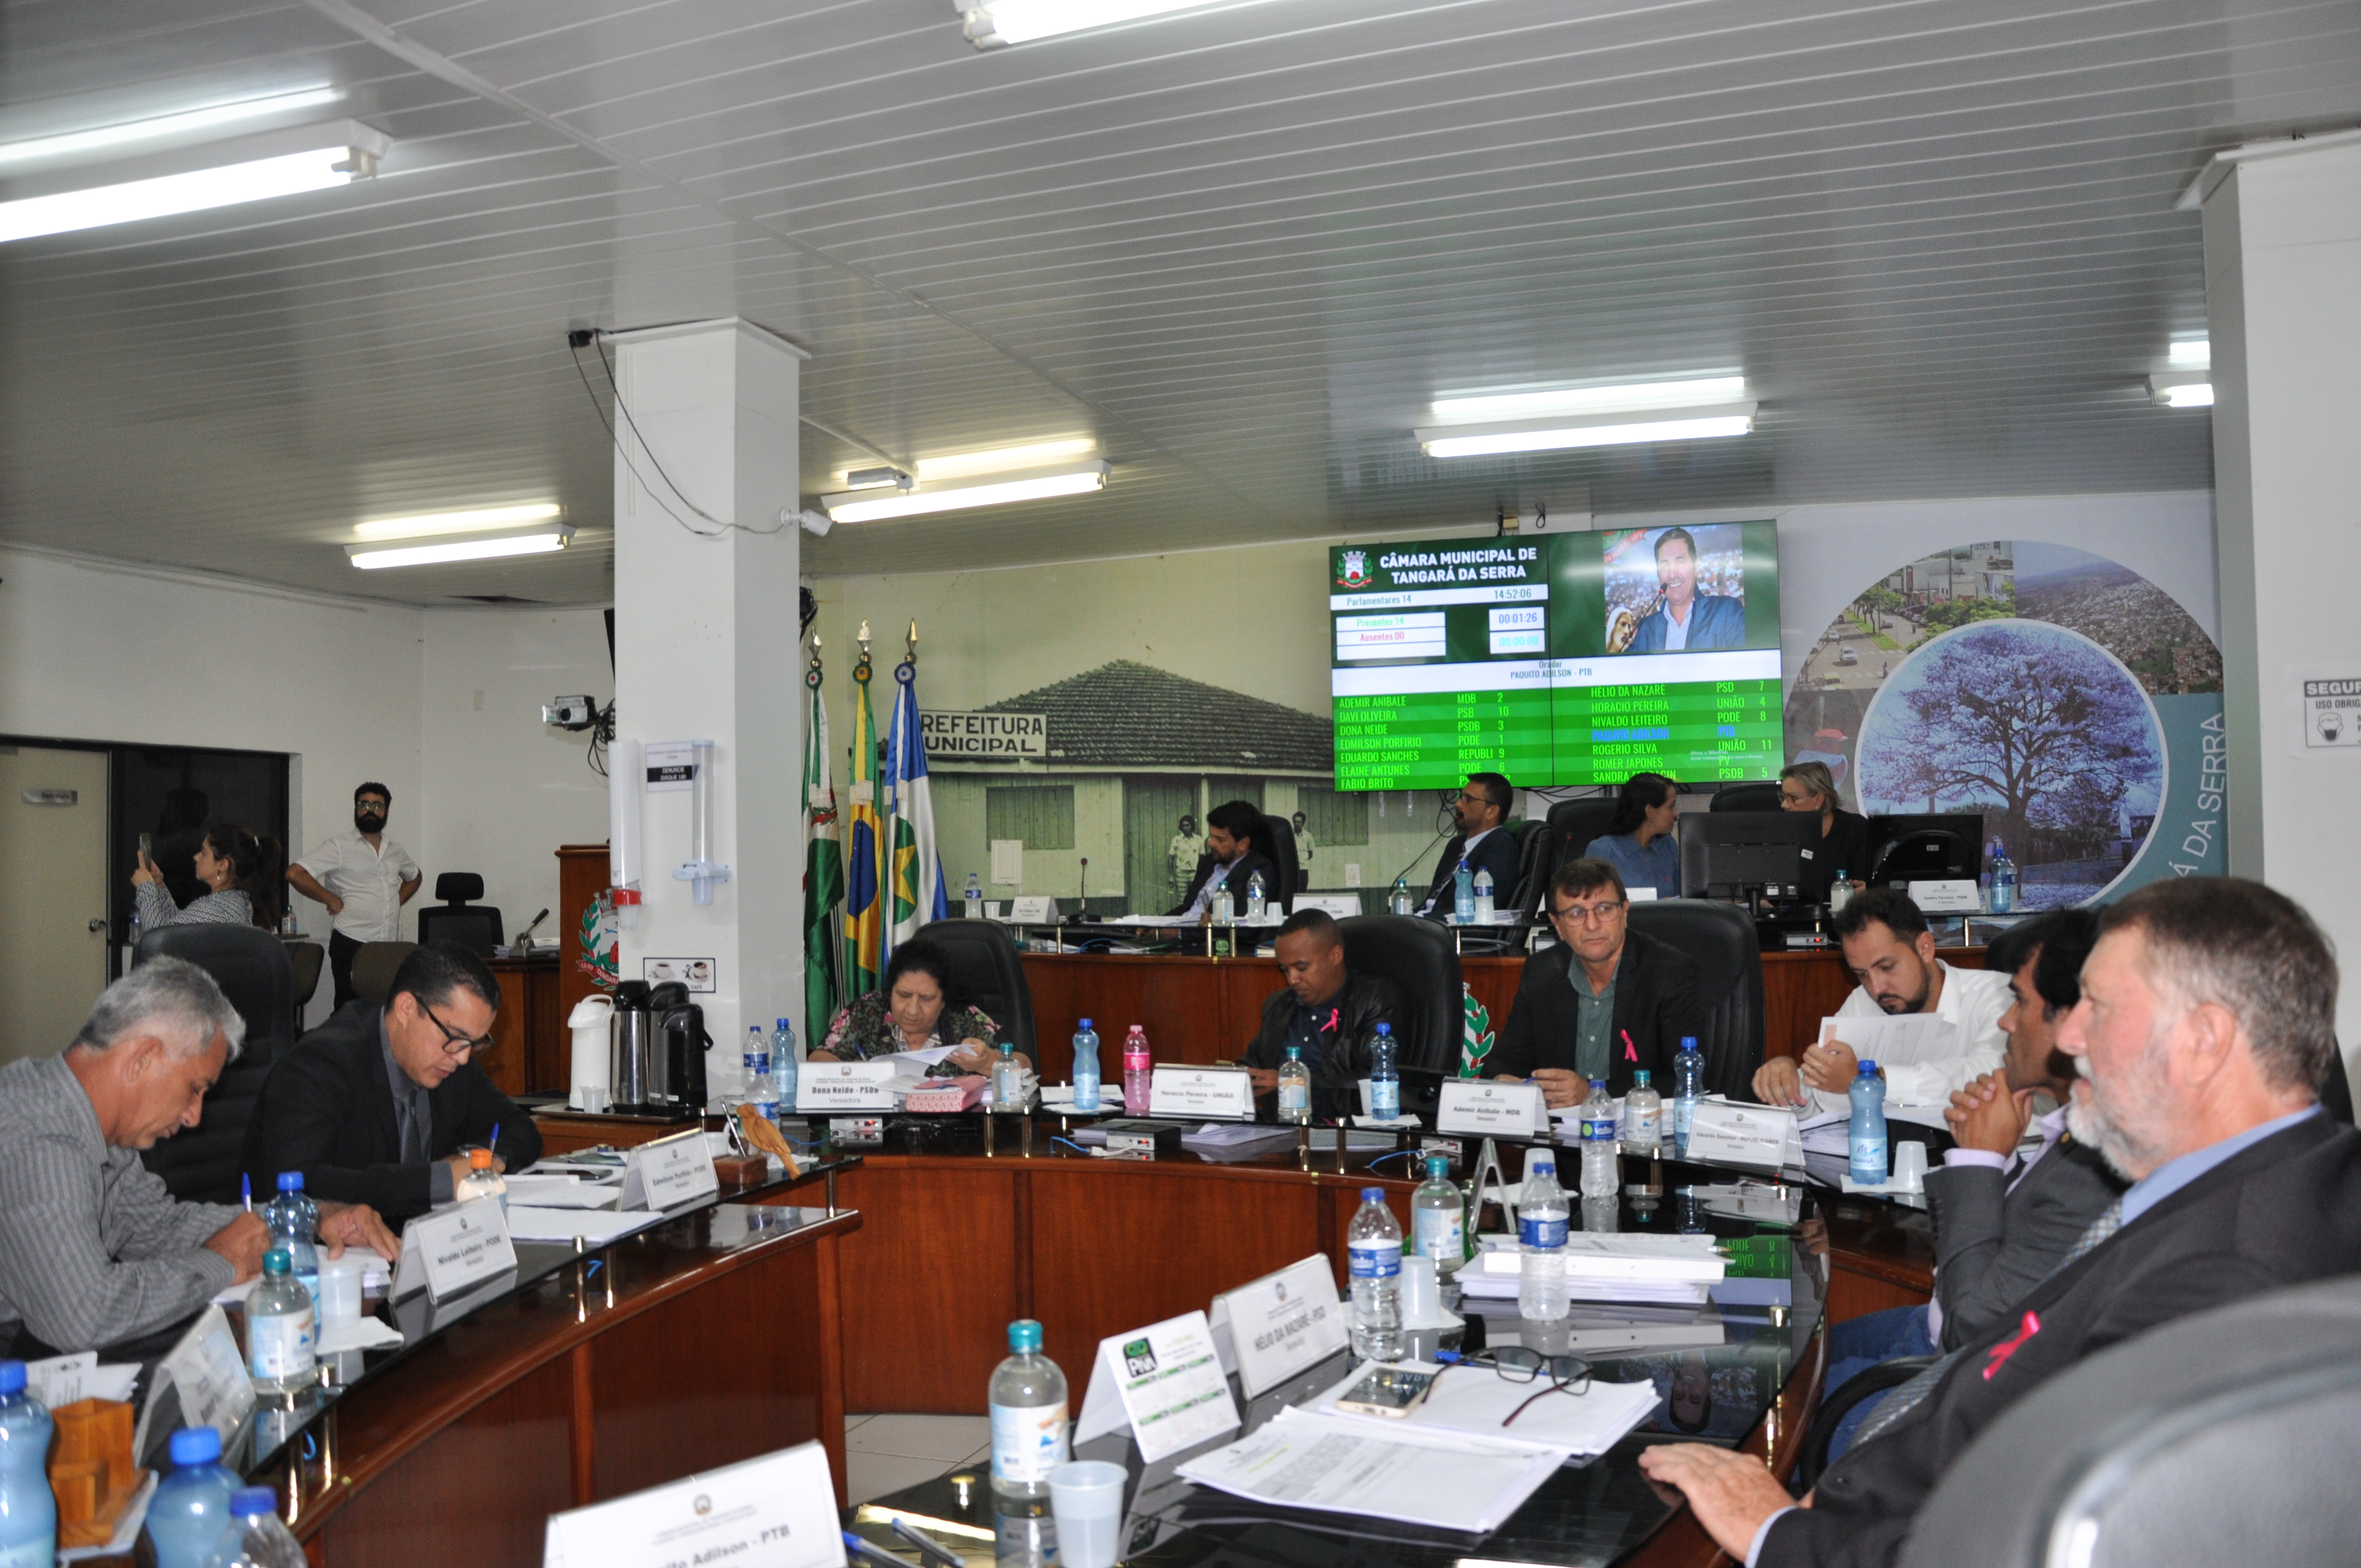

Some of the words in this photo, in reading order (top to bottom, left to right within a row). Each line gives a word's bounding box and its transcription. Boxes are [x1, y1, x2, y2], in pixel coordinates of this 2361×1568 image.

[1380, 552, 1438, 568] CÂMARA
[1440, 549, 1515, 565] MUNICIPAL
[1518, 548, 1537, 560] DE
[1391, 566, 1455, 584] TANGARÁ
[1458, 568, 1477, 580] DA
[1479, 565, 1527, 579] SERRA
[1347, 596, 1400, 606] Parlamentares
[1402, 595, 1411, 603] 14
[1494, 589, 1532, 600] 14:52:06
[1357, 618, 1393, 627] Presentes
[1395, 617, 1404, 625] 14
[1498, 612, 1537, 624] 00:01:26
[1360, 633, 1393, 642] Ausentes
[1395, 631, 1405, 640] 00
[1499, 635, 1539, 647] 00:00:00
[1539, 660, 1562, 669] Orador
[1510, 670, 1539, 679] PAQUITO
[1542, 669, 1571, 678] ADILSON
[1579, 668, 1592, 676] PTB
[1591, 684, 1616, 698] HÉLIO
[1618, 686, 1630, 696] DA
[1633, 682, 1666, 696] NAZARÉ
[1717, 682, 1734, 693] PSD
[1759, 681, 1765, 691] 7
[1339, 698, 1370, 709] ADEMIR
[1373, 696, 1406, 707] ANIBALE
[1457, 693, 1476, 704] MDB
[1497, 692, 1503, 703] 2
[1591, 702, 1630, 713] HORACIO
[1633, 700, 1669, 711] PEREIRA
[1717, 695, 1745, 708] UNIÃO
[1759, 696, 1766, 707] 4
[2316, 700, 2332, 709] USO
[2335, 699, 2361, 709] OBRIG
[1340, 712, 1359, 722] DAVI
[1361, 710, 1397, 721] OLIVEIRA
[1458, 707, 1474, 718] PSB
[1498, 706, 1509, 716] 10
[1592, 716, 1629, 727] NIVALDO
[1631, 714, 1667, 726] LEITEIRO
[1717, 711, 1740, 723] PODE
[1760, 711, 1766, 721] 8
[920, 714, 1043, 735] REFEITURA
[1340, 725, 1363, 736] DONA
[1364, 724, 1388, 735] NEIDE
[1458, 721, 1480, 732] PSDB
[1498, 720, 1504, 731] 3
[1340, 738, 1381, 749] EDMILSON
[1383, 737, 1422, 748] PORFIRIO
[1459, 735, 1479, 745] PODE
[1499, 734, 1504, 744] 1
[1592, 729, 1629, 742] PAQUITO
[1631, 728, 1669, 740] ADILSON
[1718, 726, 1735, 737] PTB
[925, 736, 1037, 752] UNICIPAL
[1592, 744, 1630, 755] ROGERIO
[1633, 743, 1657, 754] SILVA
[1718, 738, 1746, 752] UNIÃO
[1761, 739, 1772, 750] 11
[1341, 752, 1379, 763] EDUARDO
[1381, 750, 1419, 761] SANCHES
[1459, 748, 1493, 759] REPUBLI
[1499, 748, 1505, 758] 9
[1593, 758, 1623, 769] ROMER
[1625, 757, 1663, 768] JAPONES
[1719, 755, 1730, 766] PV
[2197, 712, 2226, 813] SERRA
[1341, 766, 1369, 776] ELAINE
[1372, 765, 1410, 775] ANTUNES
[1459, 763, 1481, 773] PODE
[1499, 762, 1505, 771] 6
[1593, 770, 1630, 782] SANDRA
[1719, 767, 1744, 779] PSDB
[1762, 767, 1768, 777] 5
[1341, 778, 1366, 789] FABIO
[1368, 777, 1394, 788] BRITO
[2183, 820, 2217, 858] DA
[693, 1542, 748, 1567] Adilson
[761, 1524, 790, 1544] PTB
